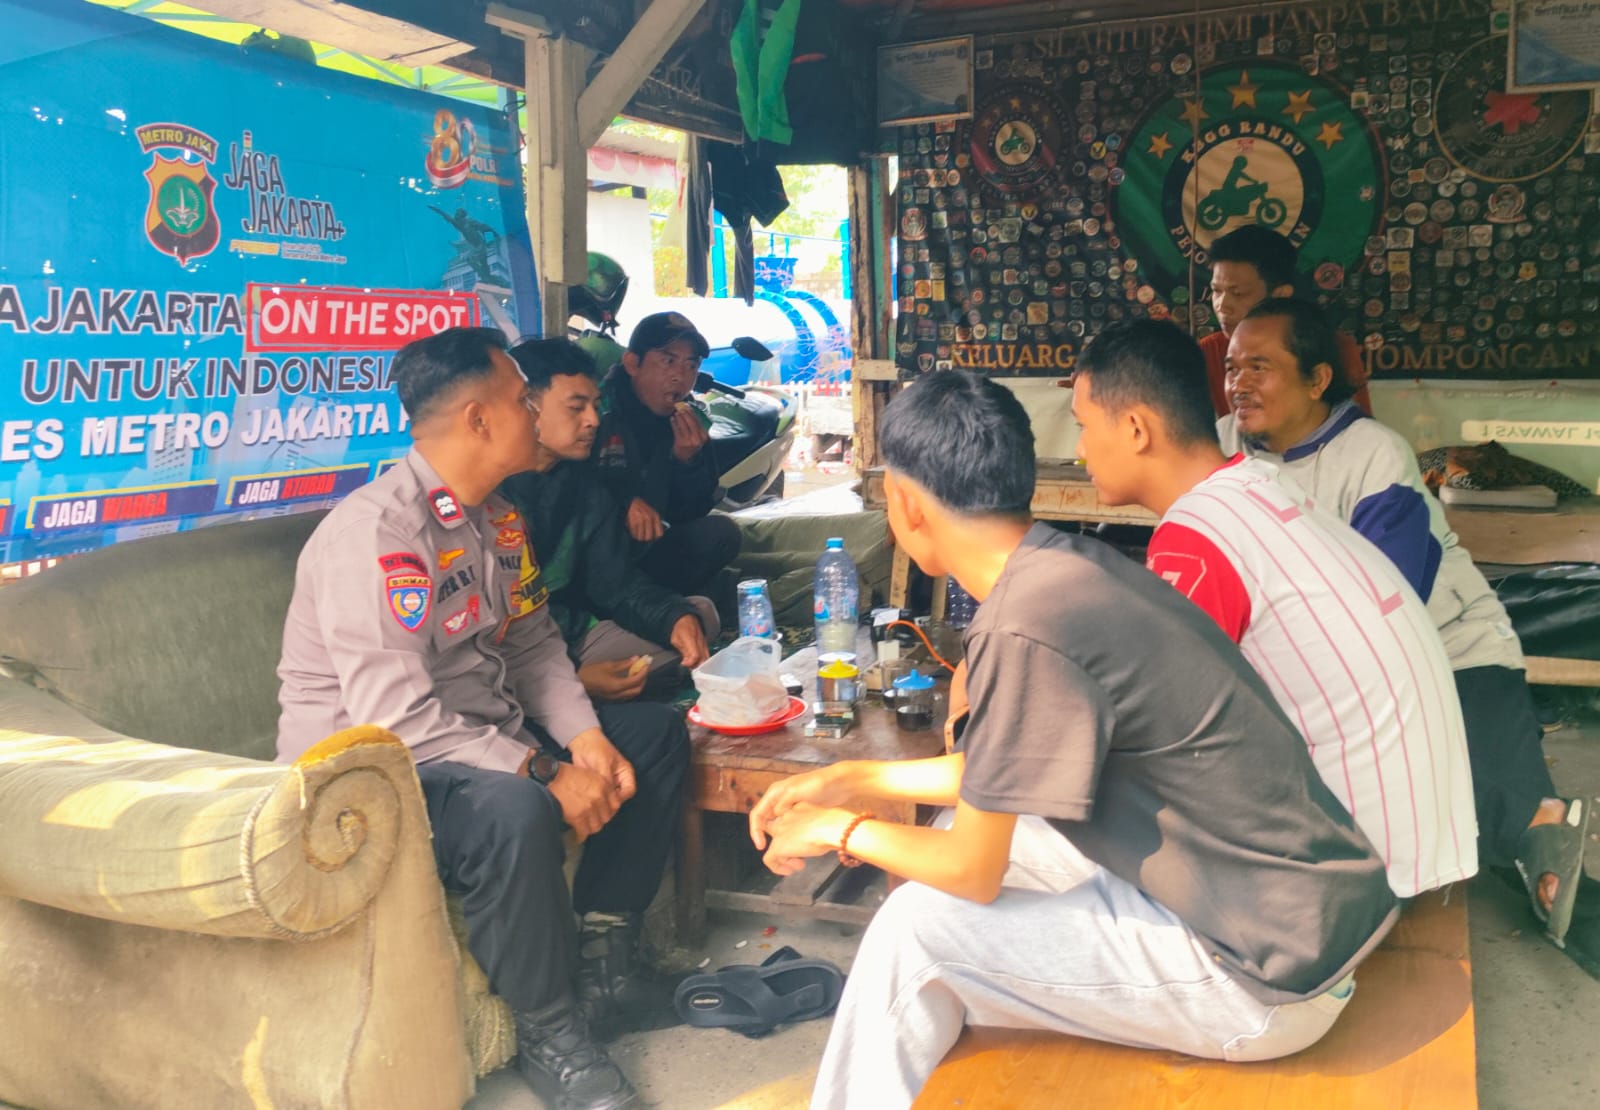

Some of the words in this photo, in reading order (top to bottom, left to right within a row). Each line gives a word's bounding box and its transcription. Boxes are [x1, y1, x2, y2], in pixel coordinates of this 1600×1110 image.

[140, 128, 183, 146] METRO
[185, 133, 213, 155] JAYA
[225, 143, 284, 194] JAGA
[32, 287, 245, 335] JAKARTA
[261, 298, 318, 335] ON
[325, 301, 387, 335] THE
[393, 302, 466, 335] SPOT
[951, 344, 1077, 369] KELUARG
[21, 357, 200, 405] UNTUK
[80, 411, 229, 457] METRO
[240, 403, 390, 446] JAKARTA
[43, 499, 97, 529] JAGA
[101, 491, 168, 523] WARGA
[239, 479, 281, 505] JAGA
[280, 473, 337, 500] ATURAN
